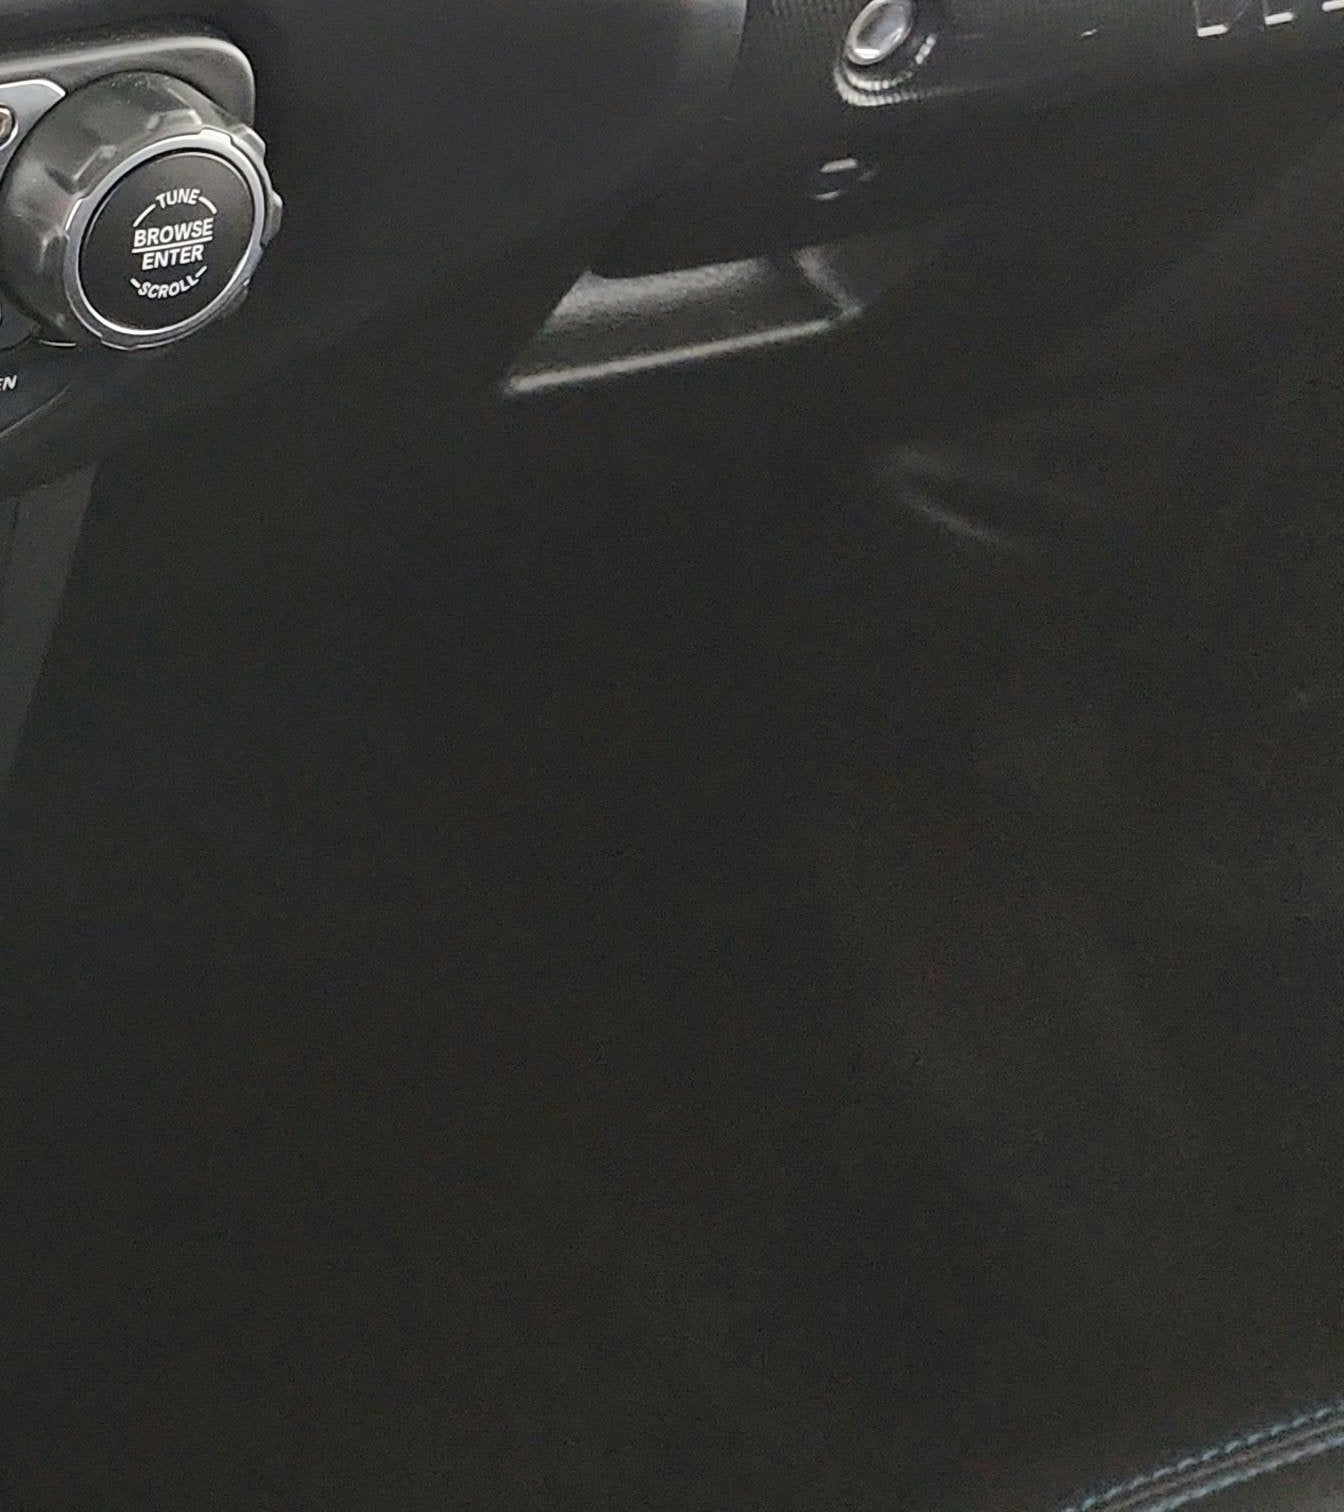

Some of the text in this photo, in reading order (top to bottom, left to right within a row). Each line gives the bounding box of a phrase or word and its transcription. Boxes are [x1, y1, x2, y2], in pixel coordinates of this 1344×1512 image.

[156, 188, 201, 208] TUNE
[134, 218, 214, 248] BROWSE
[142, 245, 204, 270] ENTER
[138, 274, 199, 299] SCROLL
